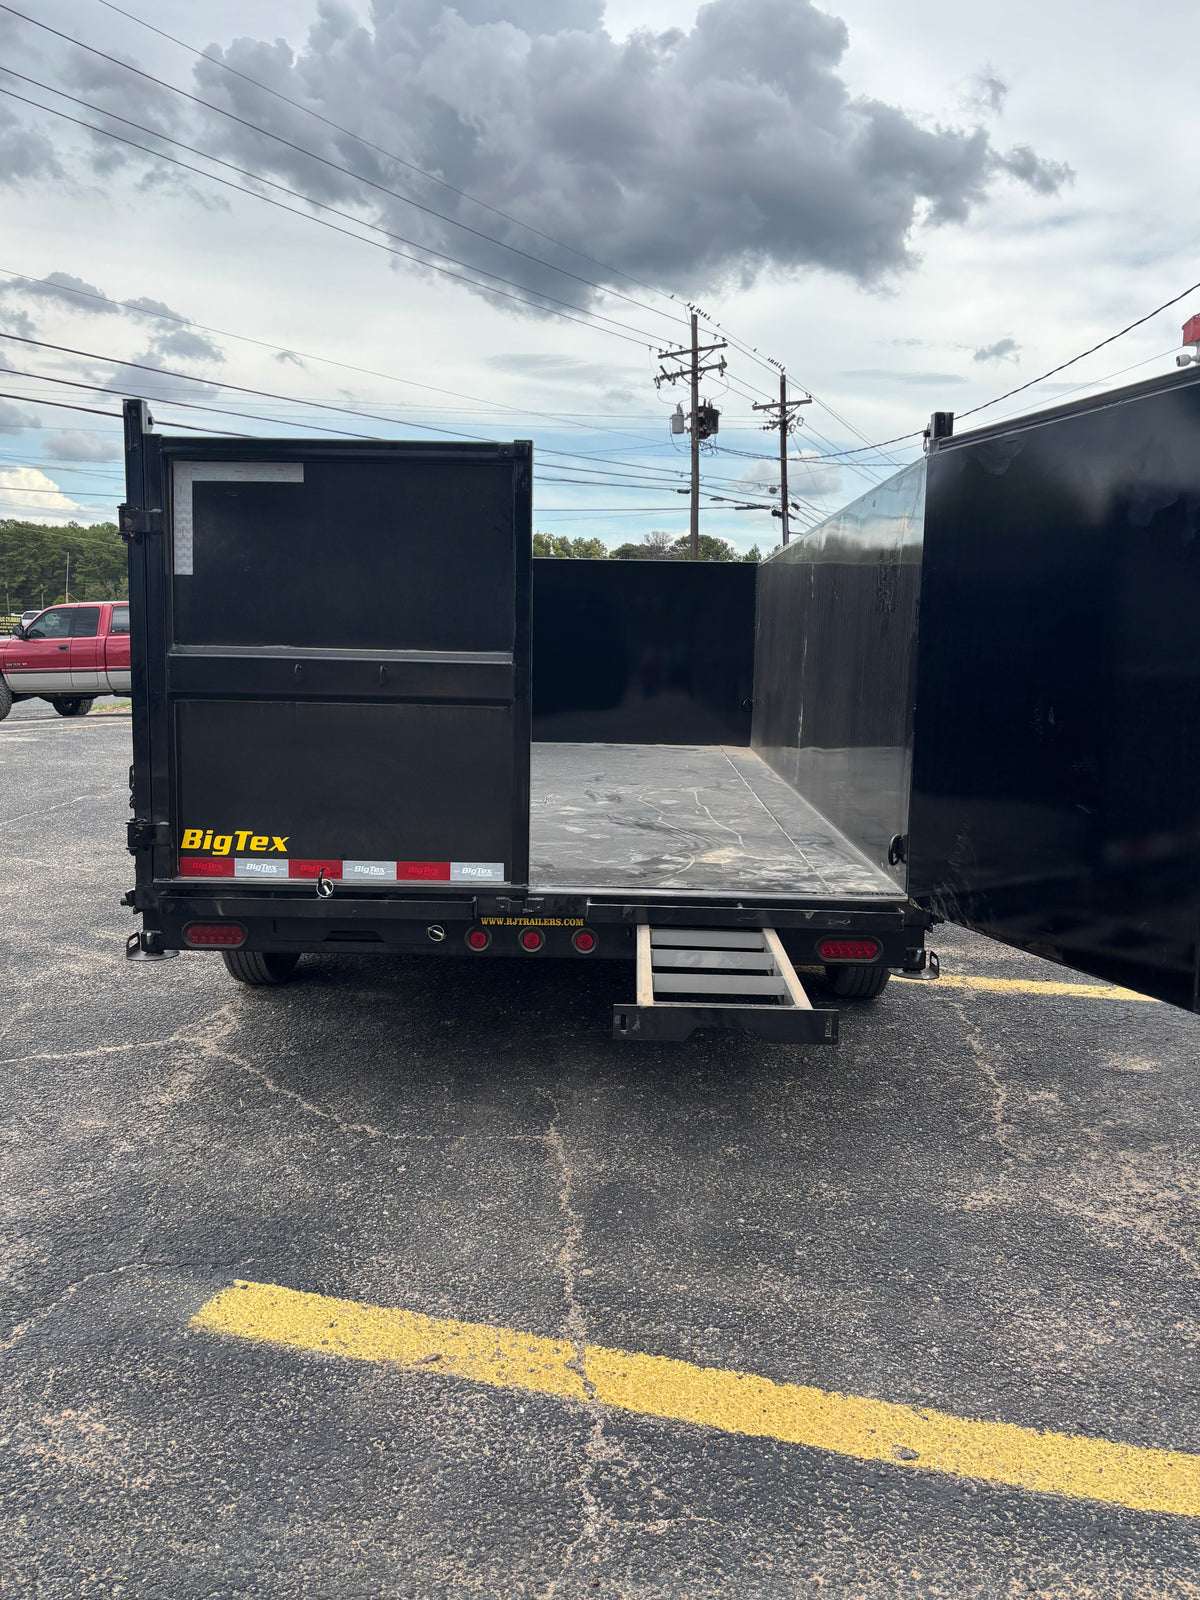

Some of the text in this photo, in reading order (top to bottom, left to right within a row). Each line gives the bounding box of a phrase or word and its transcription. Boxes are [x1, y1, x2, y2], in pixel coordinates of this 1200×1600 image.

[181, 829, 290, 855] BigTex
[246, 863, 278, 872] BigTex
[354, 865, 386, 874] BigTex
[462, 867, 492, 876] BigTex
[481, 917, 584, 926] WWW.RJTRAILERS.COM
